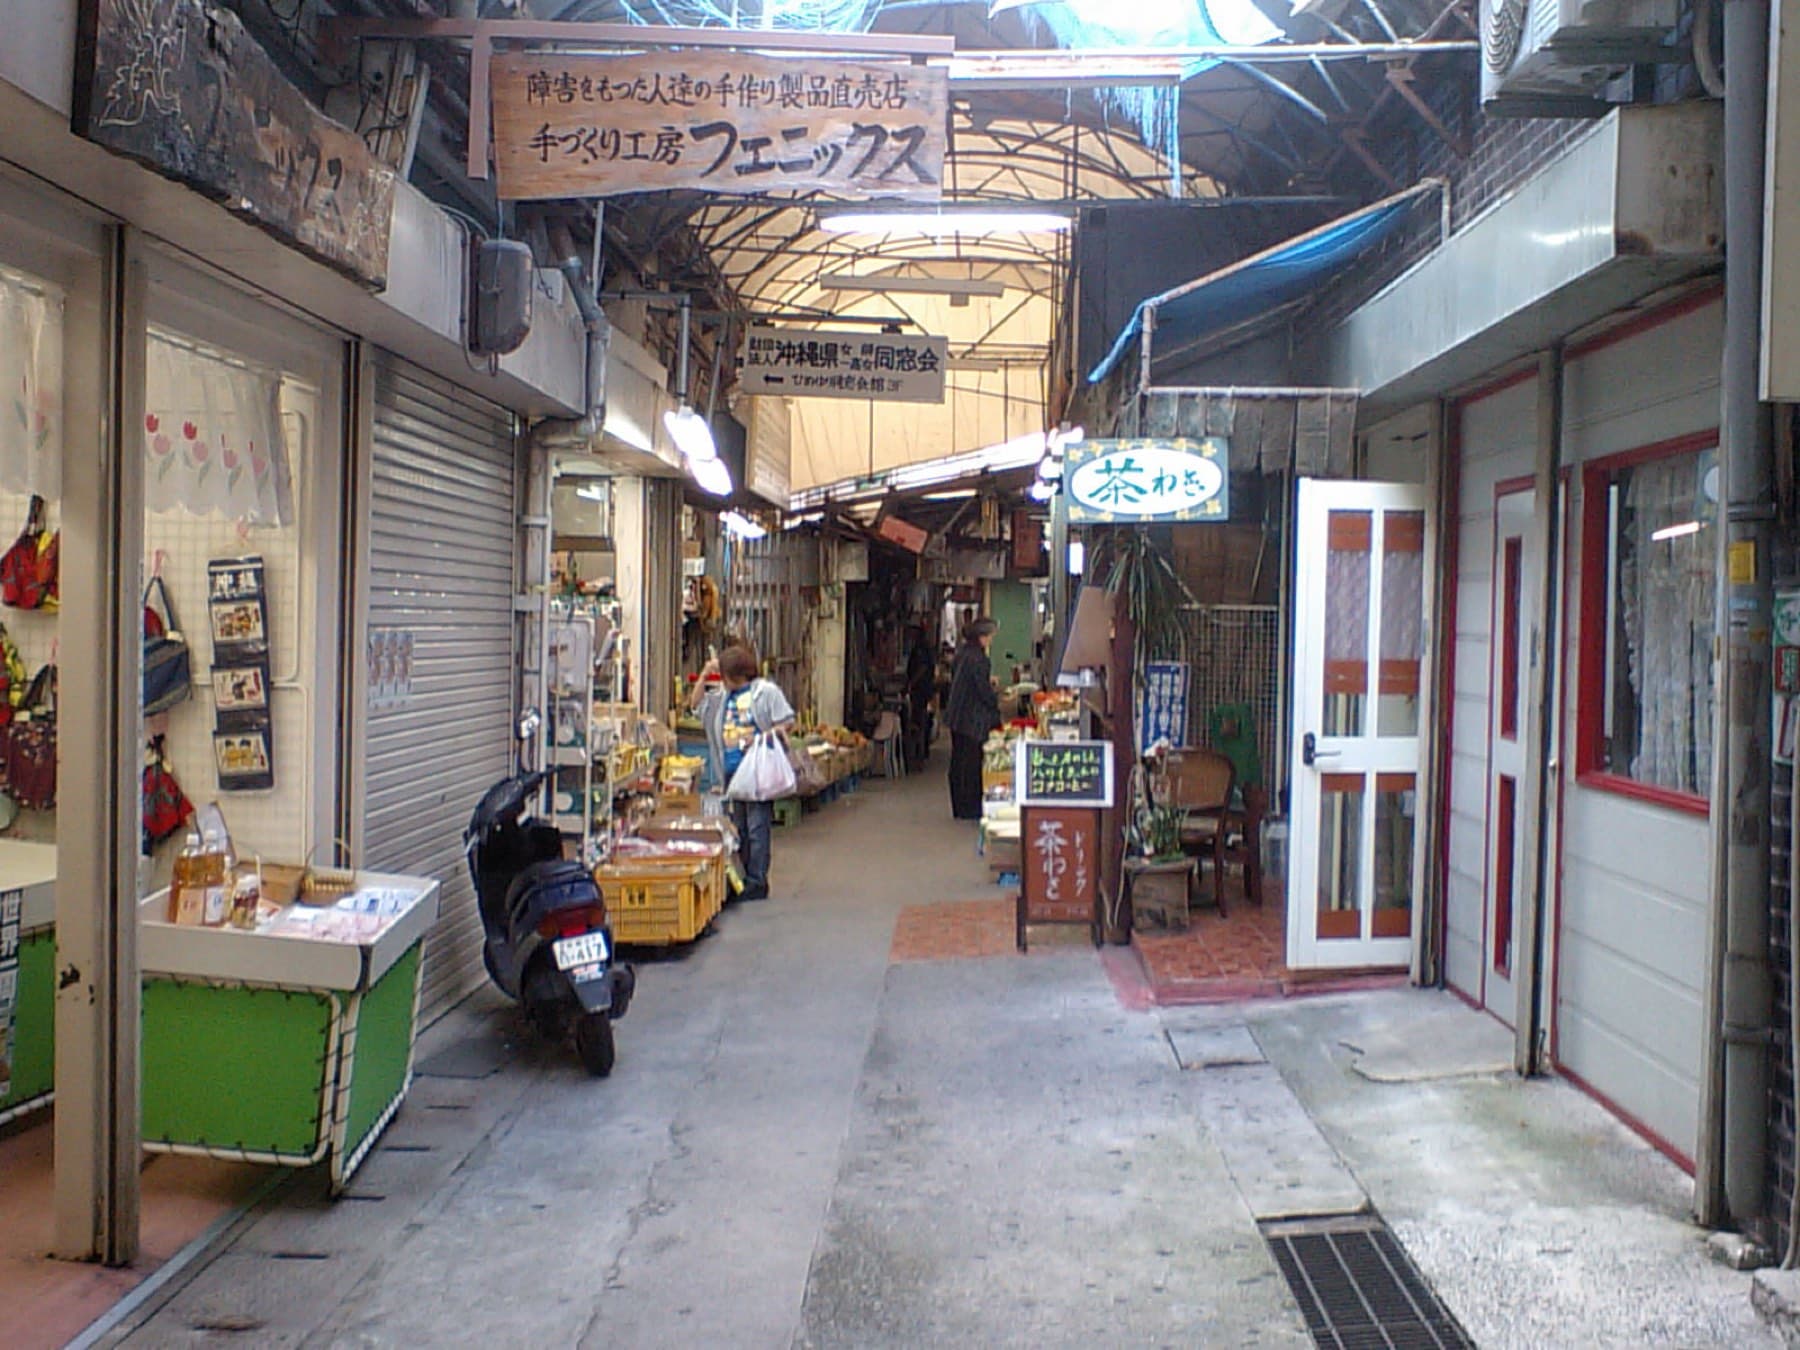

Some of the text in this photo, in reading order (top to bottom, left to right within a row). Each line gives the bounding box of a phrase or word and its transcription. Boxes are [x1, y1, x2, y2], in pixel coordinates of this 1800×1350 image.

[527, 71, 909, 109] 障害をもった人達の手作り製品直売店
